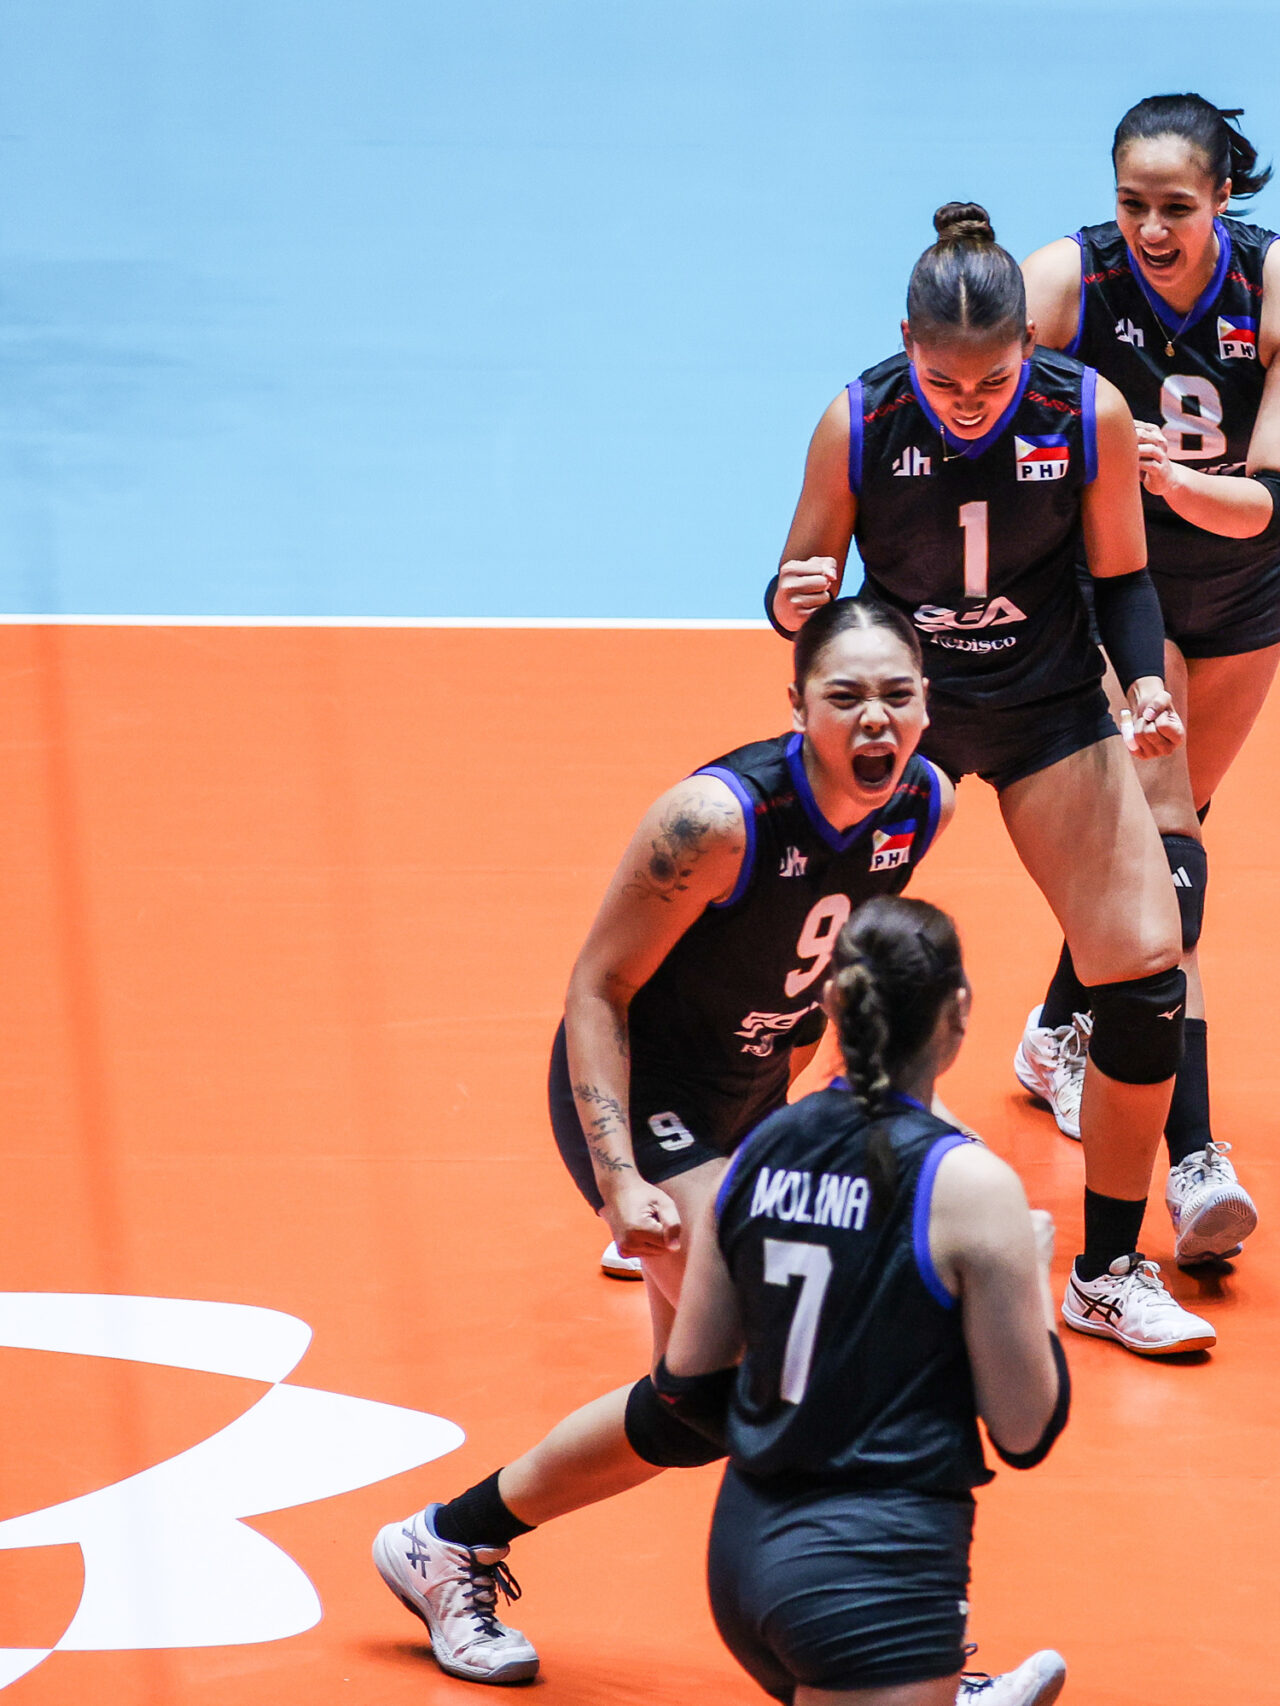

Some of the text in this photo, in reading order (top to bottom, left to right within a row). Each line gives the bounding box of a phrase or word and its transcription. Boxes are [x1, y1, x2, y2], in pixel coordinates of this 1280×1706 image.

[1160, 374, 1228, 461] 8
[1022, 464, 1065, 479] PHI
[959, 501, 988, 598] 1
[875, 852, 907, 868] PH
[784, 893, 851, 998] 9
[648, 1111, 695, 1151] 9
[751, 1166, 871, 1231] MOLINA
[763, 1237, 833, 1405] 7
